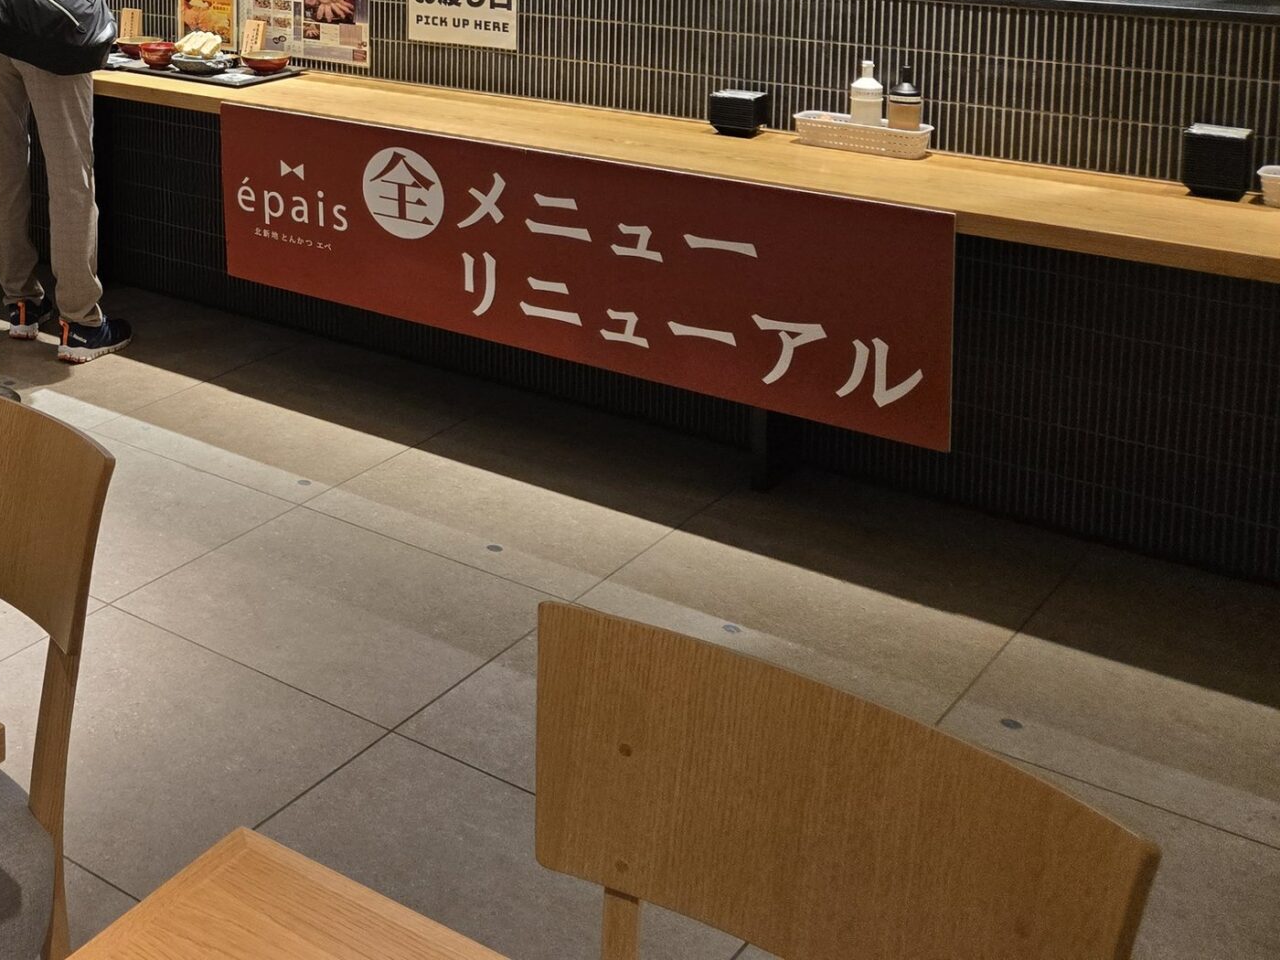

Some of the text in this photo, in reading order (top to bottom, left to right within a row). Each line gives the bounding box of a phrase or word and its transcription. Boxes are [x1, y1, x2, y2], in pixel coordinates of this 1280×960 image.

[416, 14, 510, 33] PICK UP HERE
[237, 177, 349, 231] épais
[461, 251, 924, 408] リニューアル
